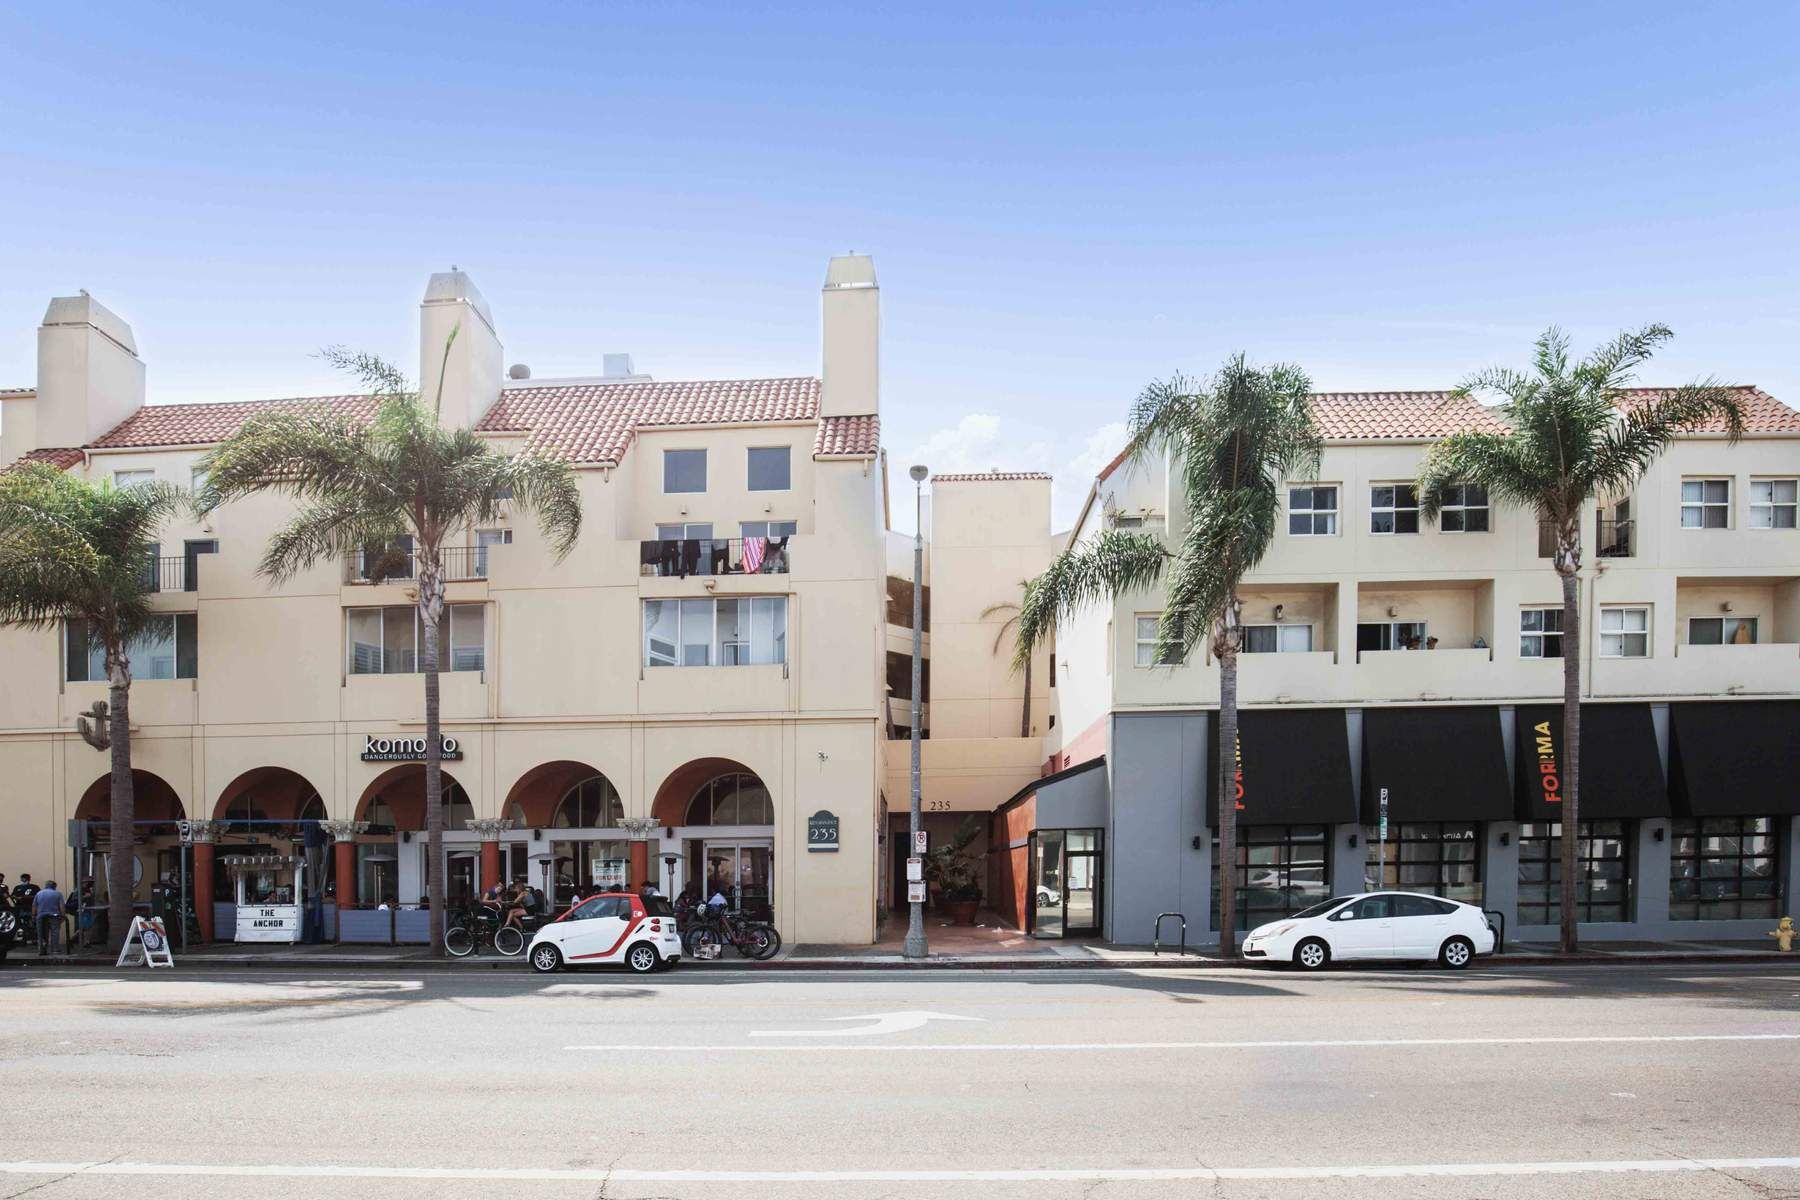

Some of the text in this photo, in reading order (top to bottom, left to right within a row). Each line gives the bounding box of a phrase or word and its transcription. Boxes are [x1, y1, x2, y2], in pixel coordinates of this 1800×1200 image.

[365, 735, 456, 753] komoo
[1534, 721, 1562, 802] FORMA
[930, 800, 951, 811] 235
[810, 828, 837, 841] 235
[260, 909, 275, 917] THE
[253, 920, 284, 928] ANCHOR
